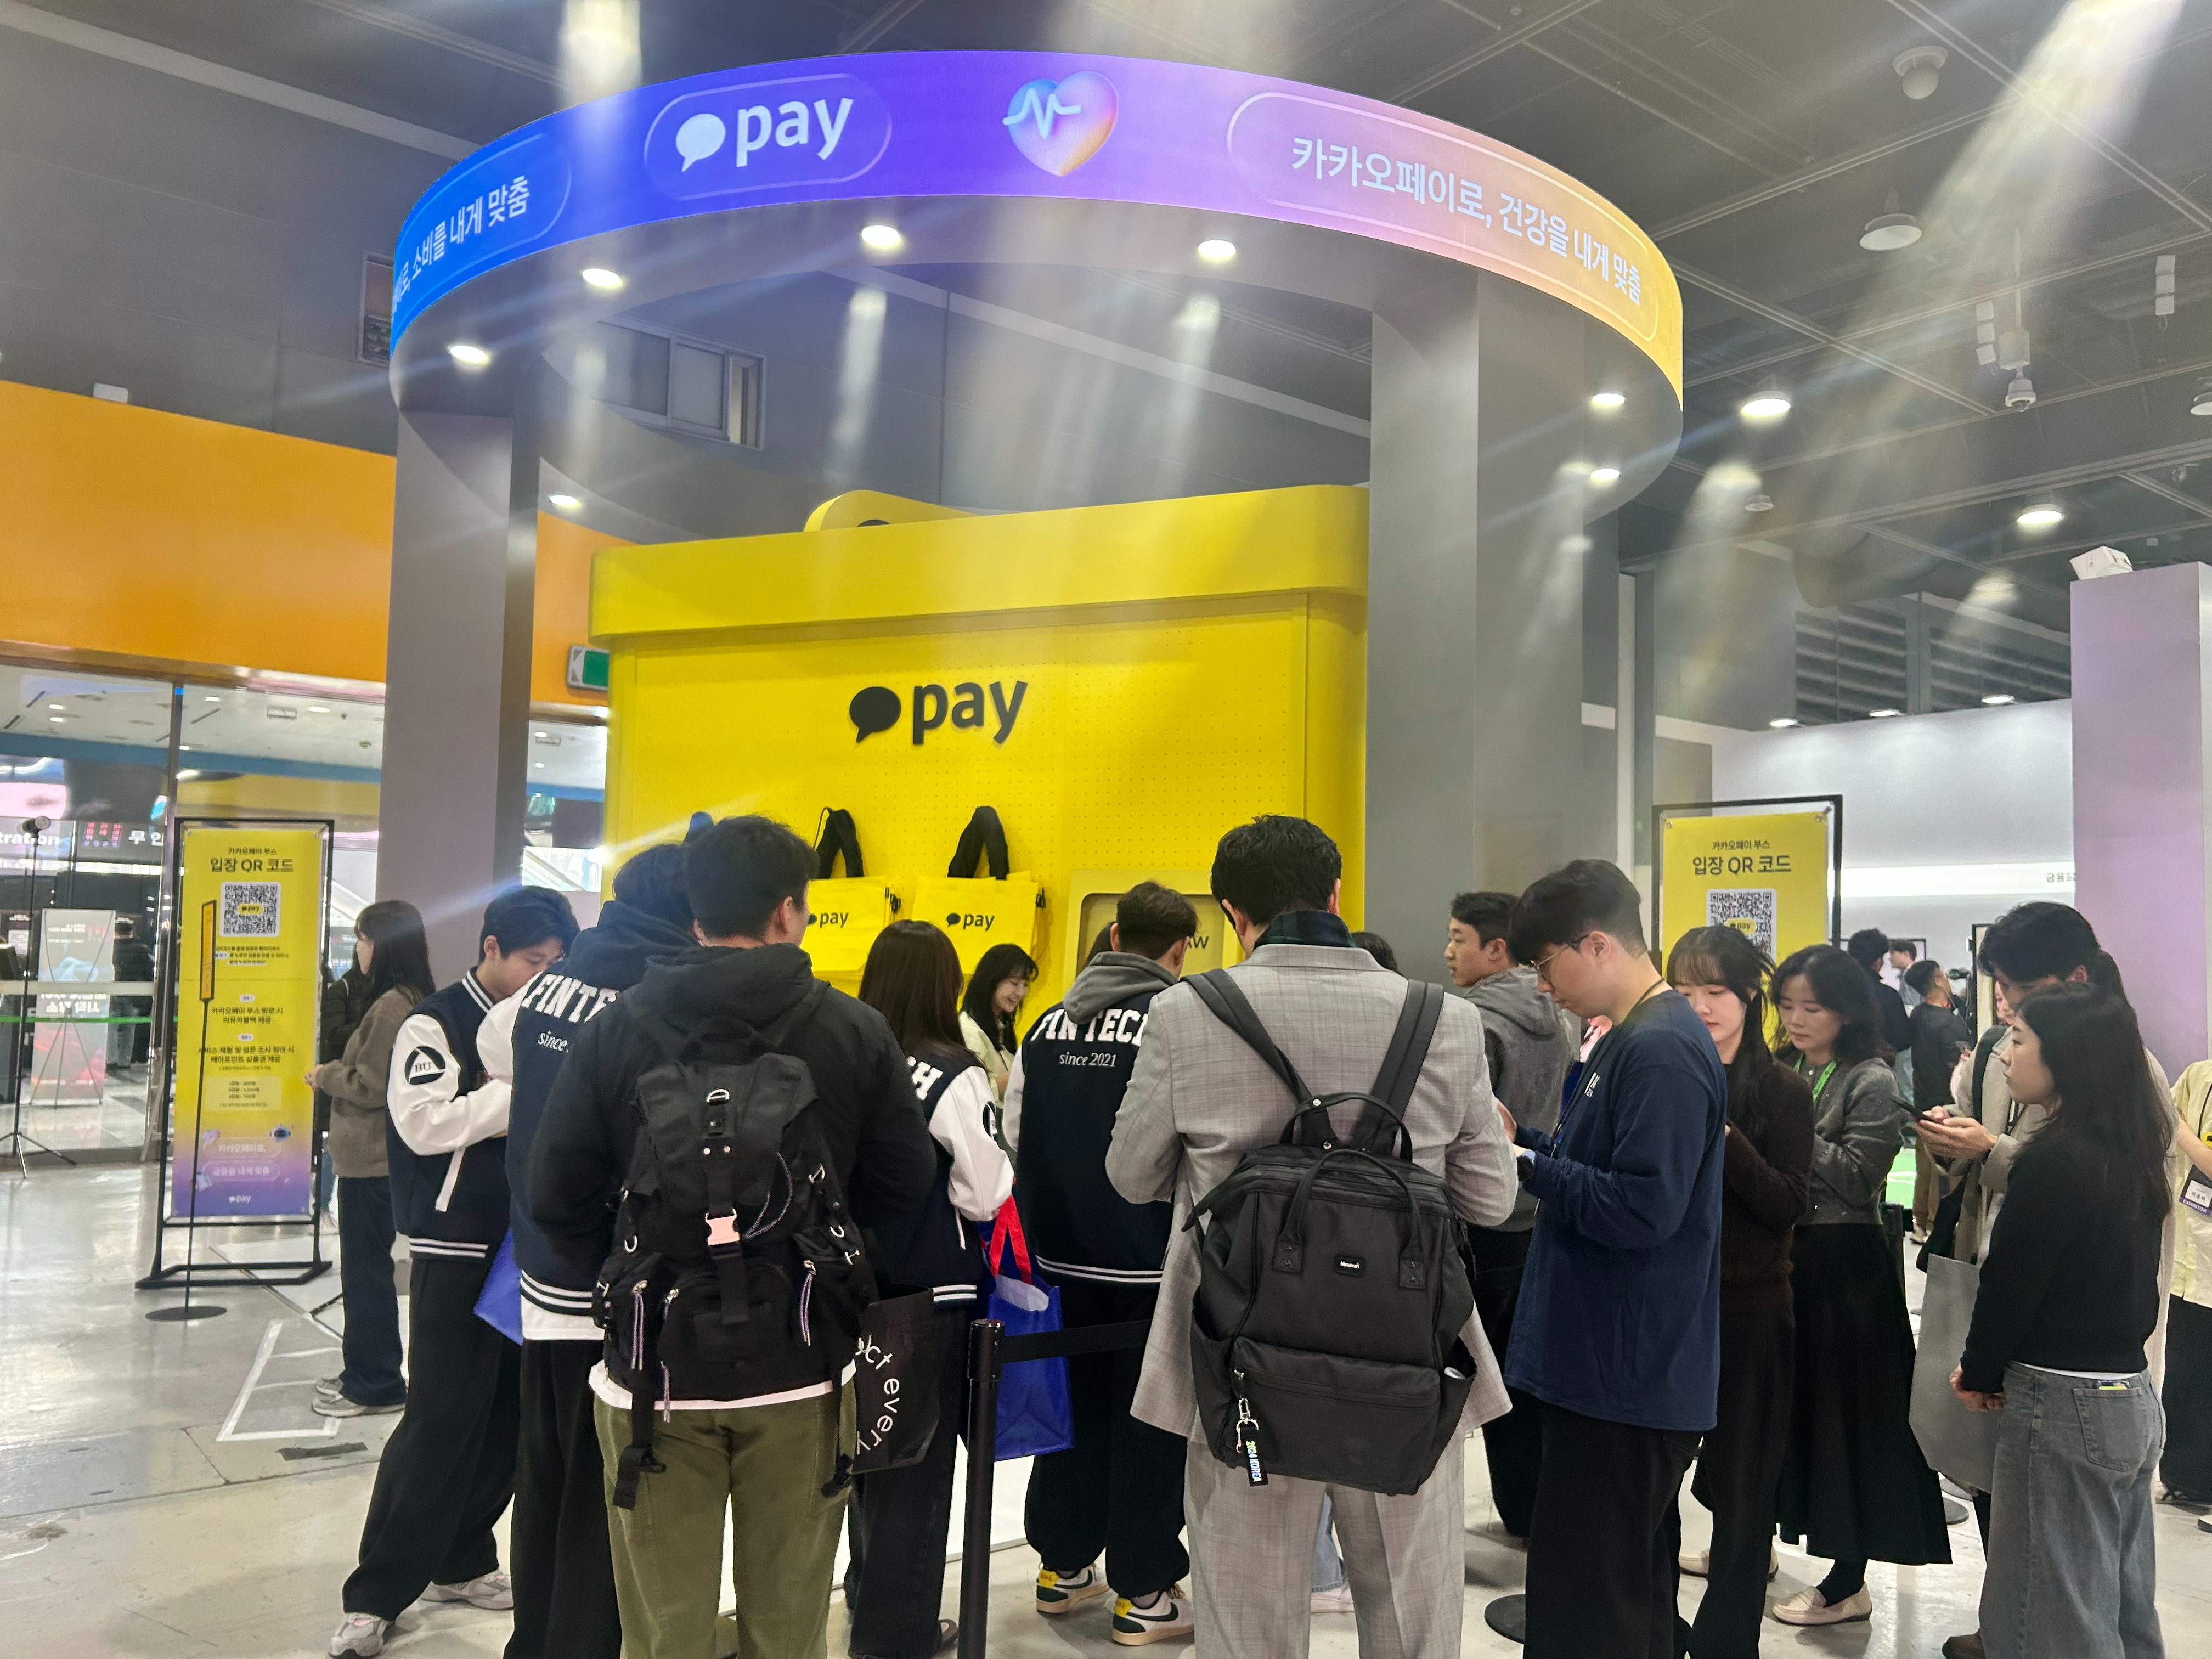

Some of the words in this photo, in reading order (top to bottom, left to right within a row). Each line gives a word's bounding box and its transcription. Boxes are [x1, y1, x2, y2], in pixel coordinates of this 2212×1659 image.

[735, 97, 854, 167] pay
[411, 220, 447, 281] 소비를
[449, 195, 483, 244] 내게
[488, 175, 531, 228] 맞춤
[1291, 136, 1493, 229] 카카오페이로,
[1498, 192, 1570, 258] 건강을
[1573, 227, 1610, 283] 내게
[1612, 252, 1643, 306] 맞춤
[912, 680, 1028, 746] pay
[228, 847, 262, 856] 카카오페이
[264, 847, 278, 856] 부스
[1712, 840, 1752, 850] 카카오페이
[1754, 840, 1770, 850] 부스
[210, 857, 238, 873] 입장
[241, 859, 263, 872] QR
[266, 858, 295, 873] 코드
[1692, 856, 1724, 876] 입장
[1728, 856, 1754, 876] QR
[1757, 855, 1792, 873] 코드
[247, 905, 261, 913] pay
[820, 911, 849, 929] pay
[963, 912, 995, 932] pay
[1737, 922, 1751, 932] pay
[538, 1030, 568, 1052] since
[1059, 1051, 1088, 1066] since
[1089, 1052, 1117, 1068] 2021
[907, 1056, 943, 1100] H
[236, 1195, 251, 1204] pay
[856, 1378, 900, 1455] every
